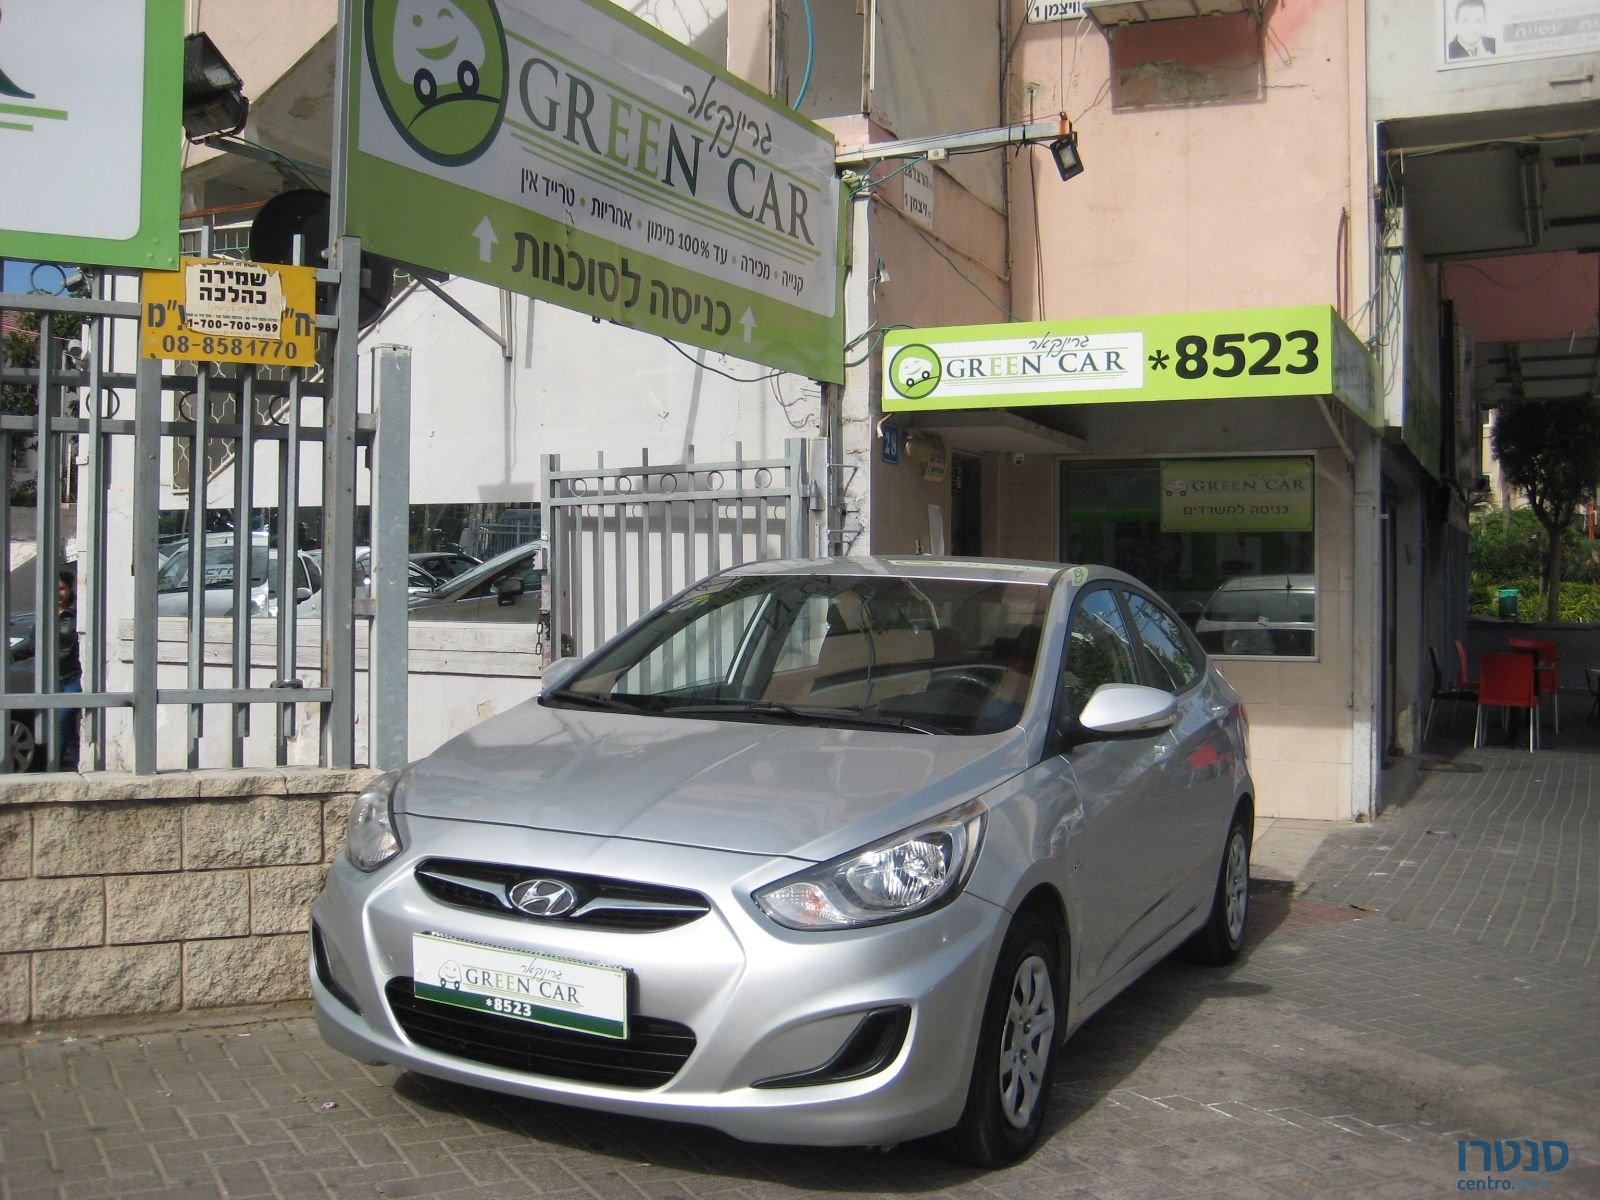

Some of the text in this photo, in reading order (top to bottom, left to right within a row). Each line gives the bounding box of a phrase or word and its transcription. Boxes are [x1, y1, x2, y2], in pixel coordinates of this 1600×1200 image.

[1034, 6, 1040, 18] 1
[682, 75, 772, 159] גרינקאר
[519, 57, 815, 246] GREEN CAR
[521, 167, 804, 296] קנייה מכירה עד 100% מימון אחריות טרייד אין
[199, 269, 267, 287] שמירה
[511, 230, 732, 336] כניסה לסוכנות
[199, 286, 267, 305] כהלכה
[187, 318, 279, 333] 1-700-700-989
[163, 335, 298, 360] 08-8581770
[1028, 331, 1090, 358] גרינקאר
[946, 351, 1125, 379] GREEN CAR
[1192, 479, 1306, 492] GREEN CAR
[1183, 504, 1289, 515] כניסה למשרדים
[520, 957, 563, 983] גרינקאר
[465, 968, 580, 1004] GREEN CAR
